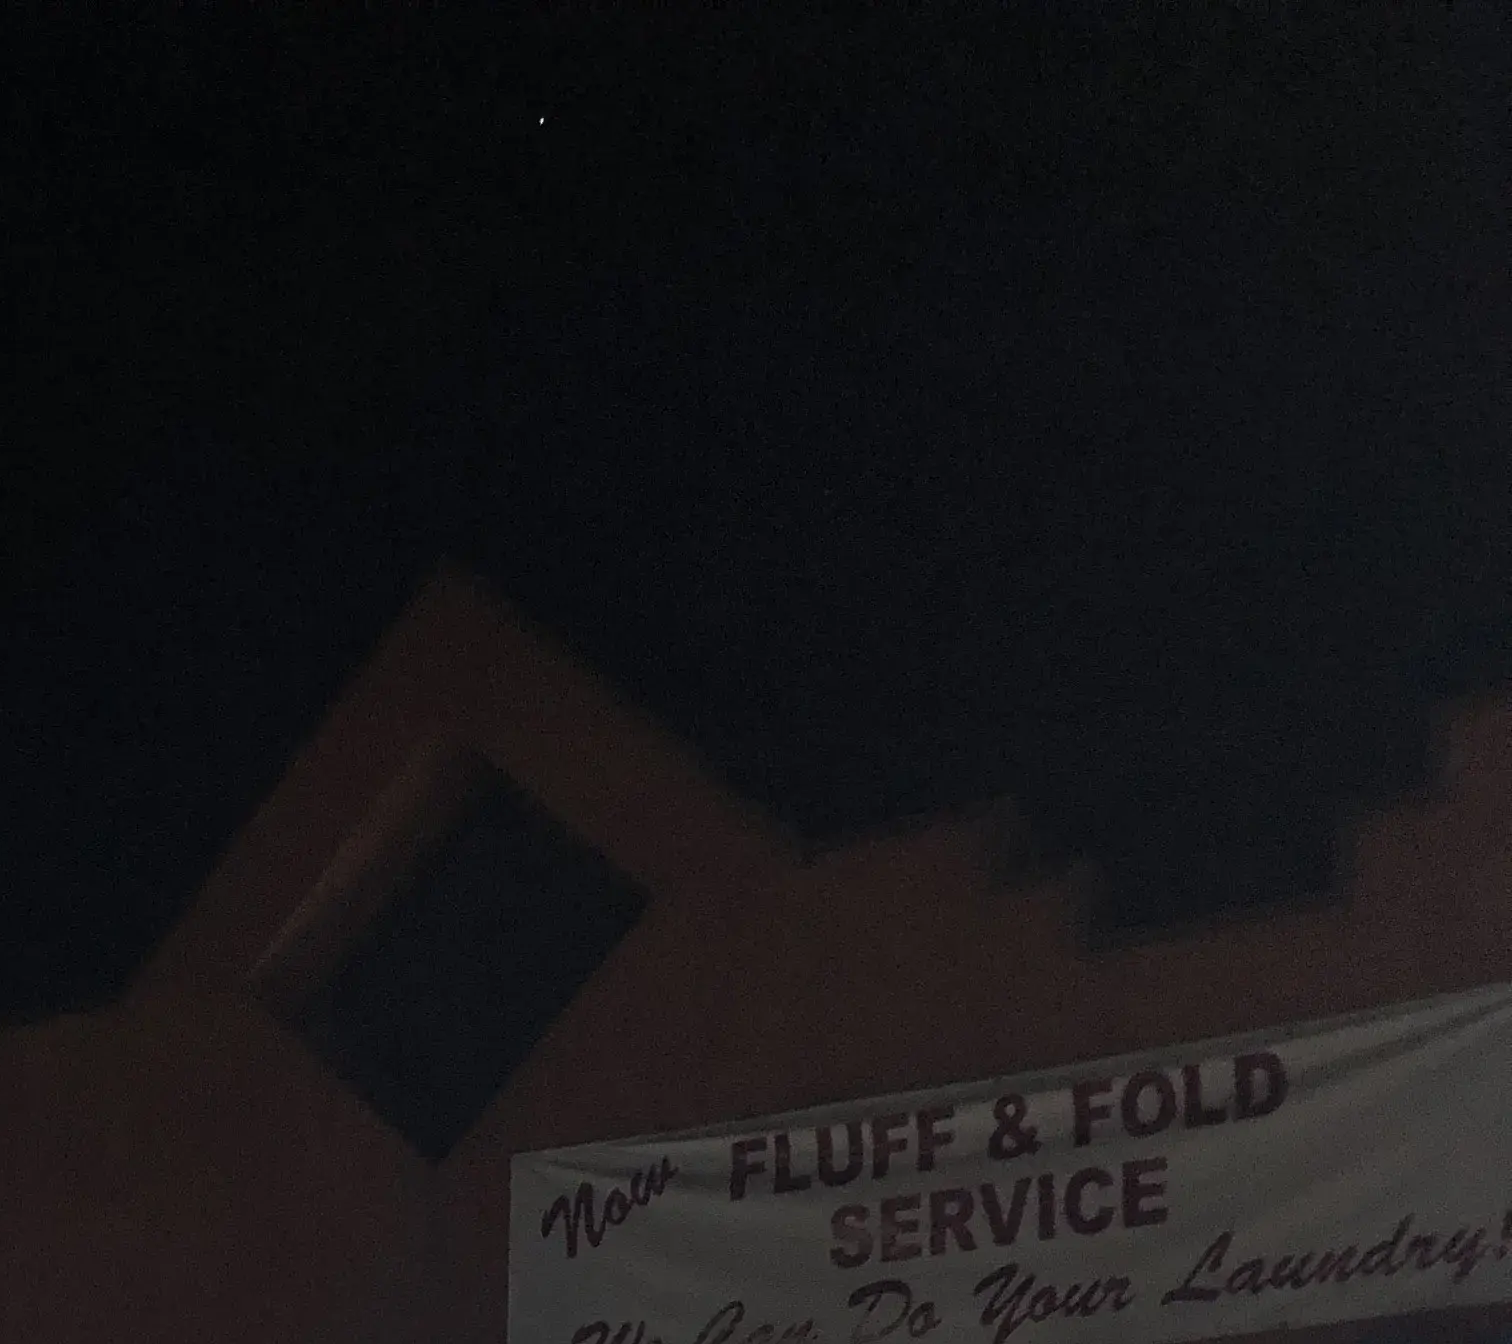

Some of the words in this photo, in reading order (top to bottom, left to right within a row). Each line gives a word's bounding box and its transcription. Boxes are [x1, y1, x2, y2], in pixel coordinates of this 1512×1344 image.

[729, 1107, 954, 1202] FLUFF
[987, 1094, 1040, 1160] &
[1073, 1052, 1288, 1147] FOLD
[540, 1157, 681, 1259] Now
[830, 1157, 1170, 1269] SERVICE
